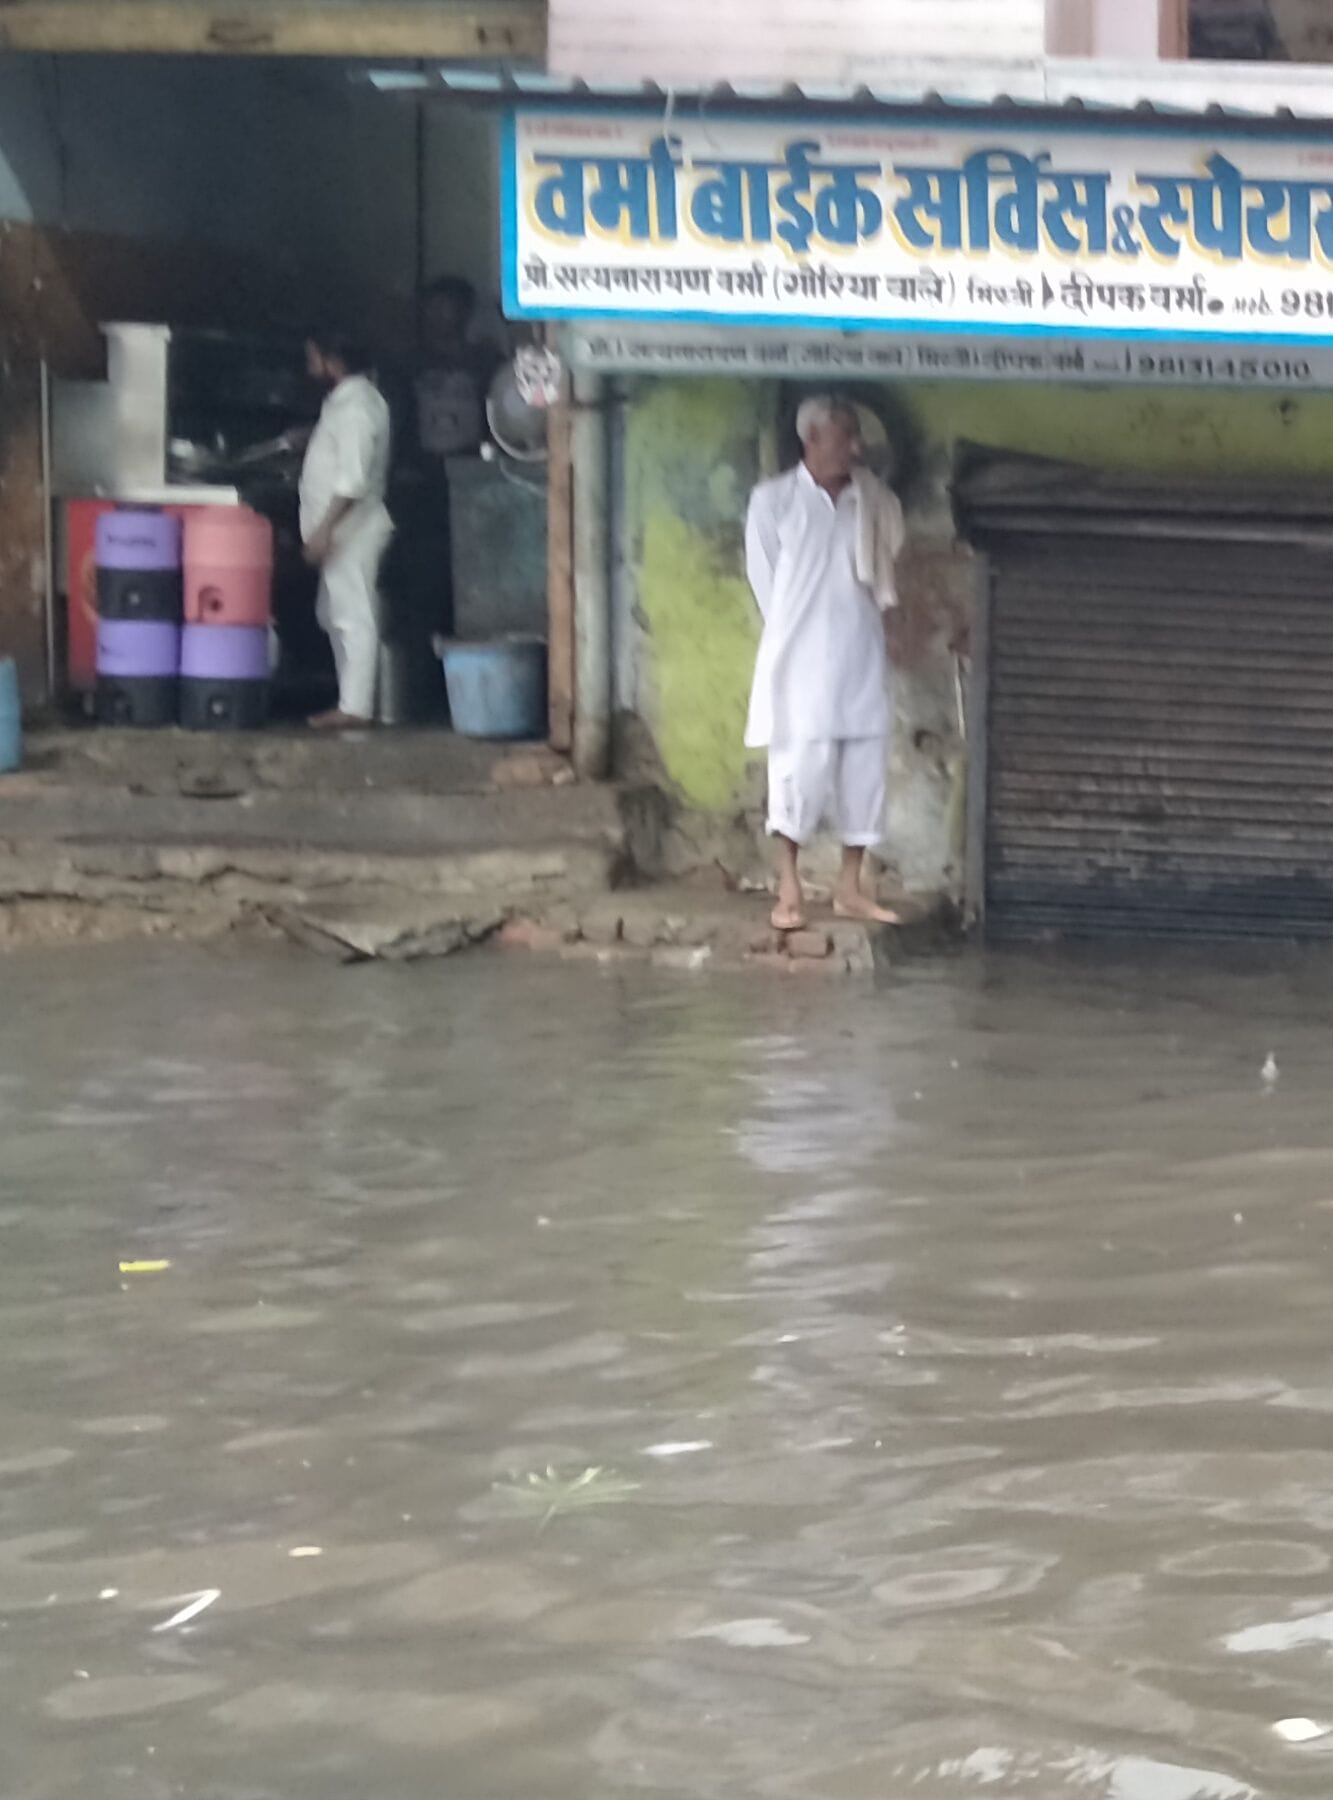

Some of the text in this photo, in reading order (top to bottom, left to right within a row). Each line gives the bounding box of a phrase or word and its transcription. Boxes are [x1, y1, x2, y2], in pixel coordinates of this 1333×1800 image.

[528, 136, 682, 242] वर्मा
[689, 140, 883, 255] बाईक
[1112, 206, 1141, 256] &
